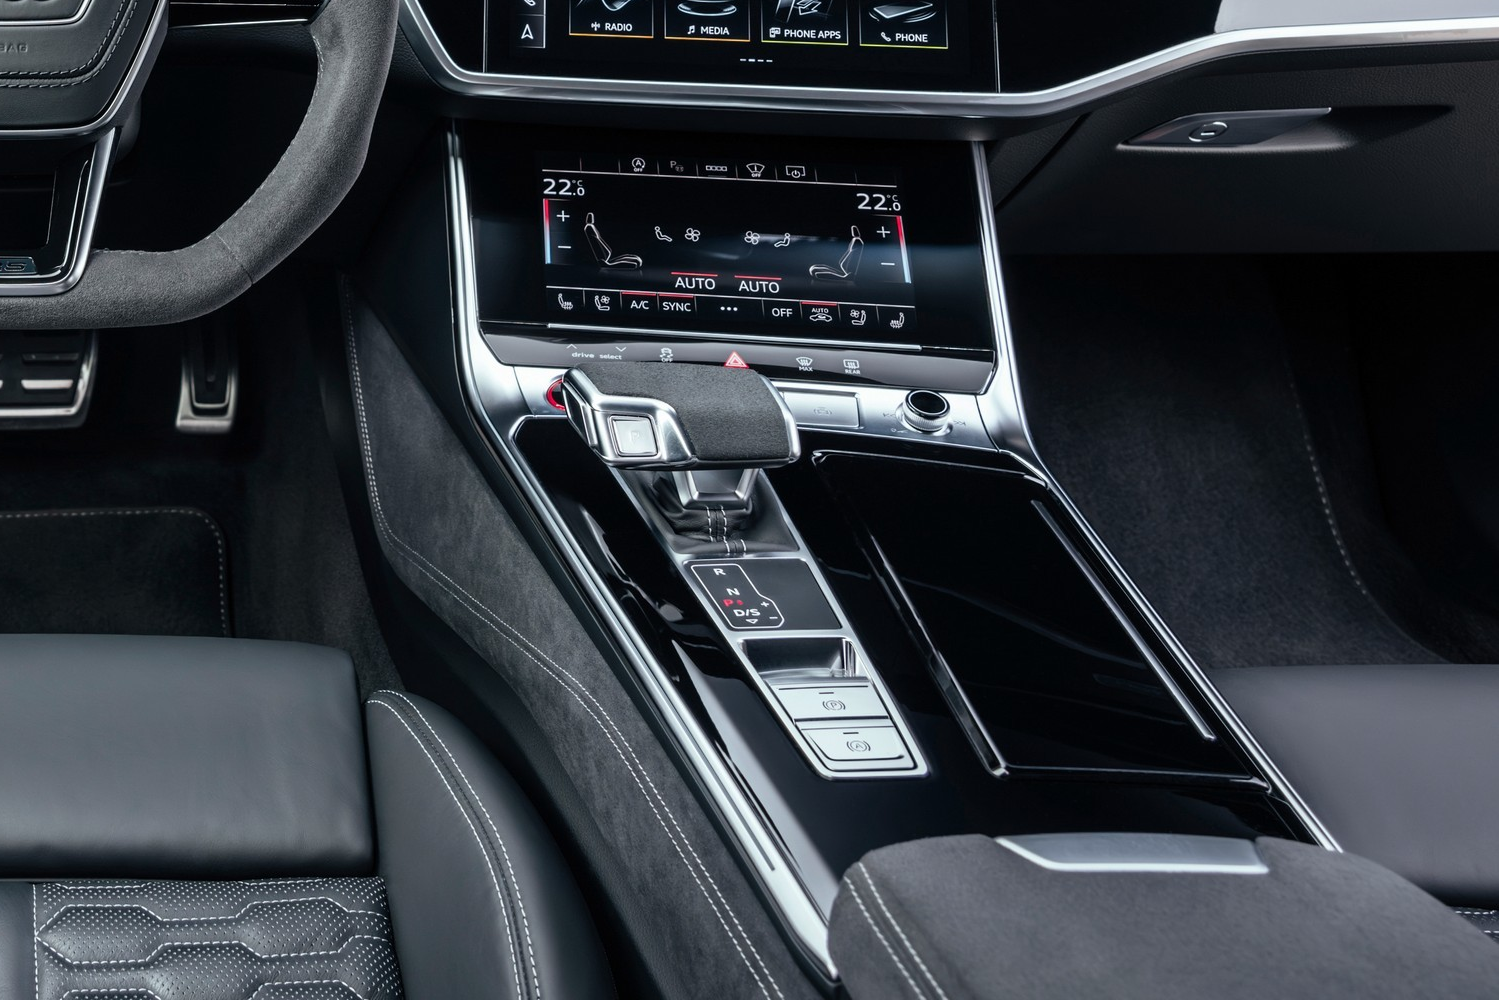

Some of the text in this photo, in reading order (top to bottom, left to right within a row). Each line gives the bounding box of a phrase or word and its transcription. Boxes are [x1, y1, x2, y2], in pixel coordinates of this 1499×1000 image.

[605, 22, 633, 32] RADIO
[701, 26, 730, 35] MEDIA
[784, 28, 842, 40] PHONE APPS
[896, 32, 929, 43] PHONE
[674, 276, 717, 291] AUTO
[738, 280, 781, 294] AUTO
[630, 300, 650, 311] A/C
[662, 301, 692, 313] SYNC
[771, 308, 793, 318] OFF
[599, 353, 623, 361] select
[723, 599, 734, 607] P
[733, 609, 761, 617] D/S
